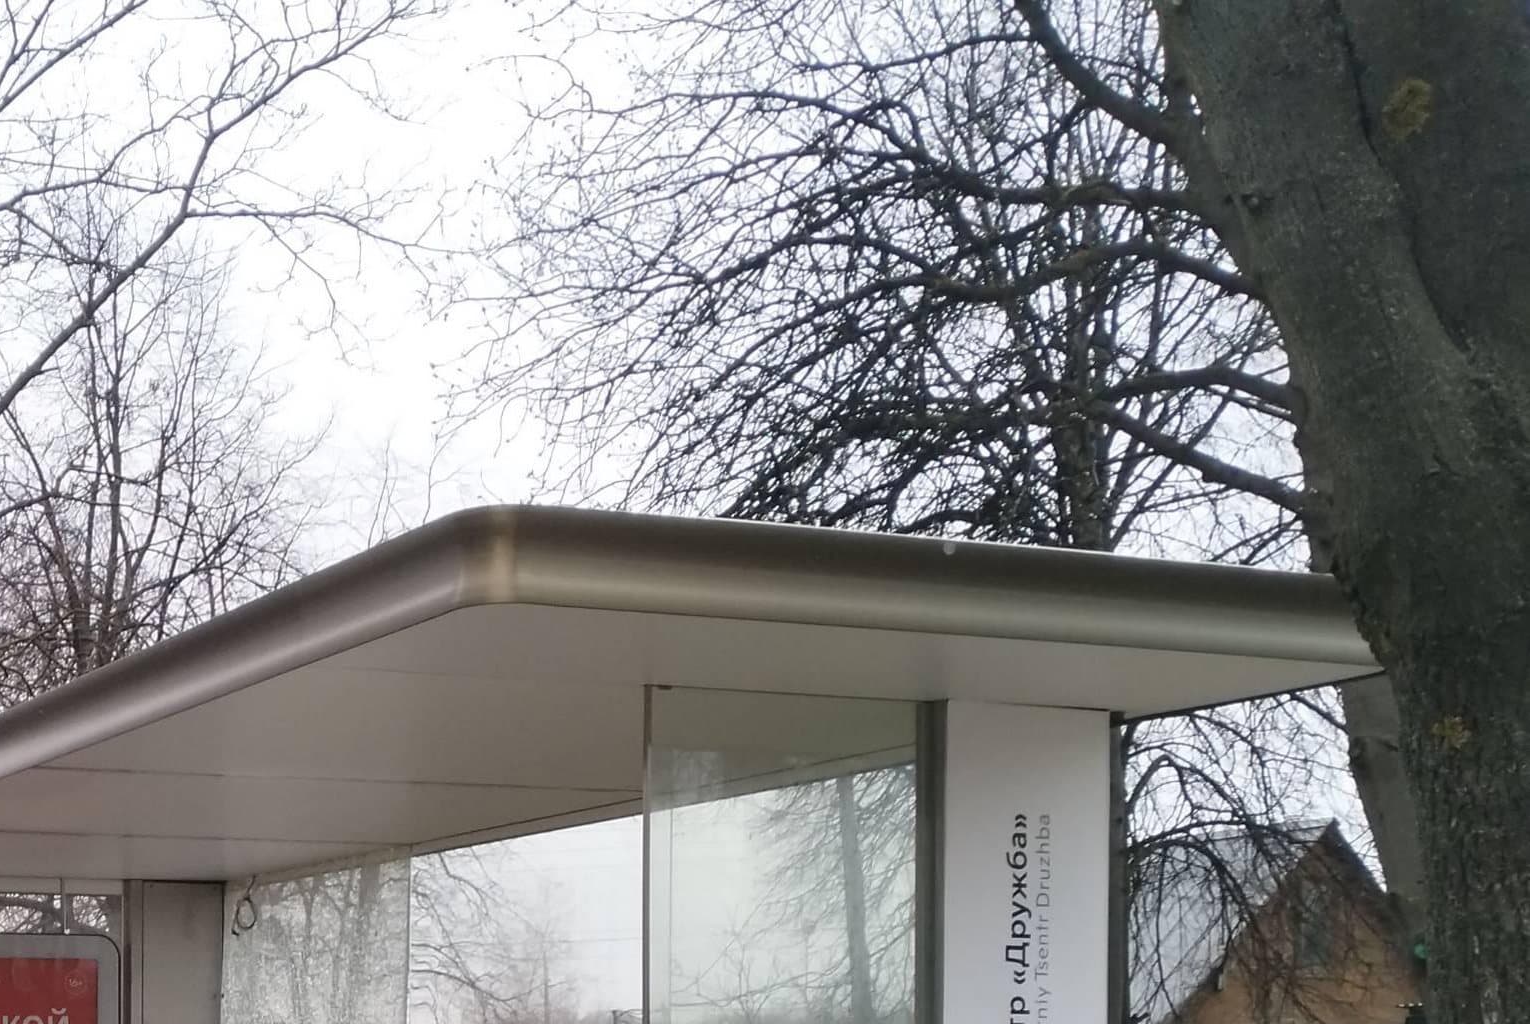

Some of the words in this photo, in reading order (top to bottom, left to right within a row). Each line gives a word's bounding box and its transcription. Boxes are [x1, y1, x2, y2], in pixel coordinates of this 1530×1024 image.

[1005, 814, 1030, 984] «Дружба»
[1035, 814, 1051, 907] Druzhba
[1034, 915, 1049, 981] Tsentr
